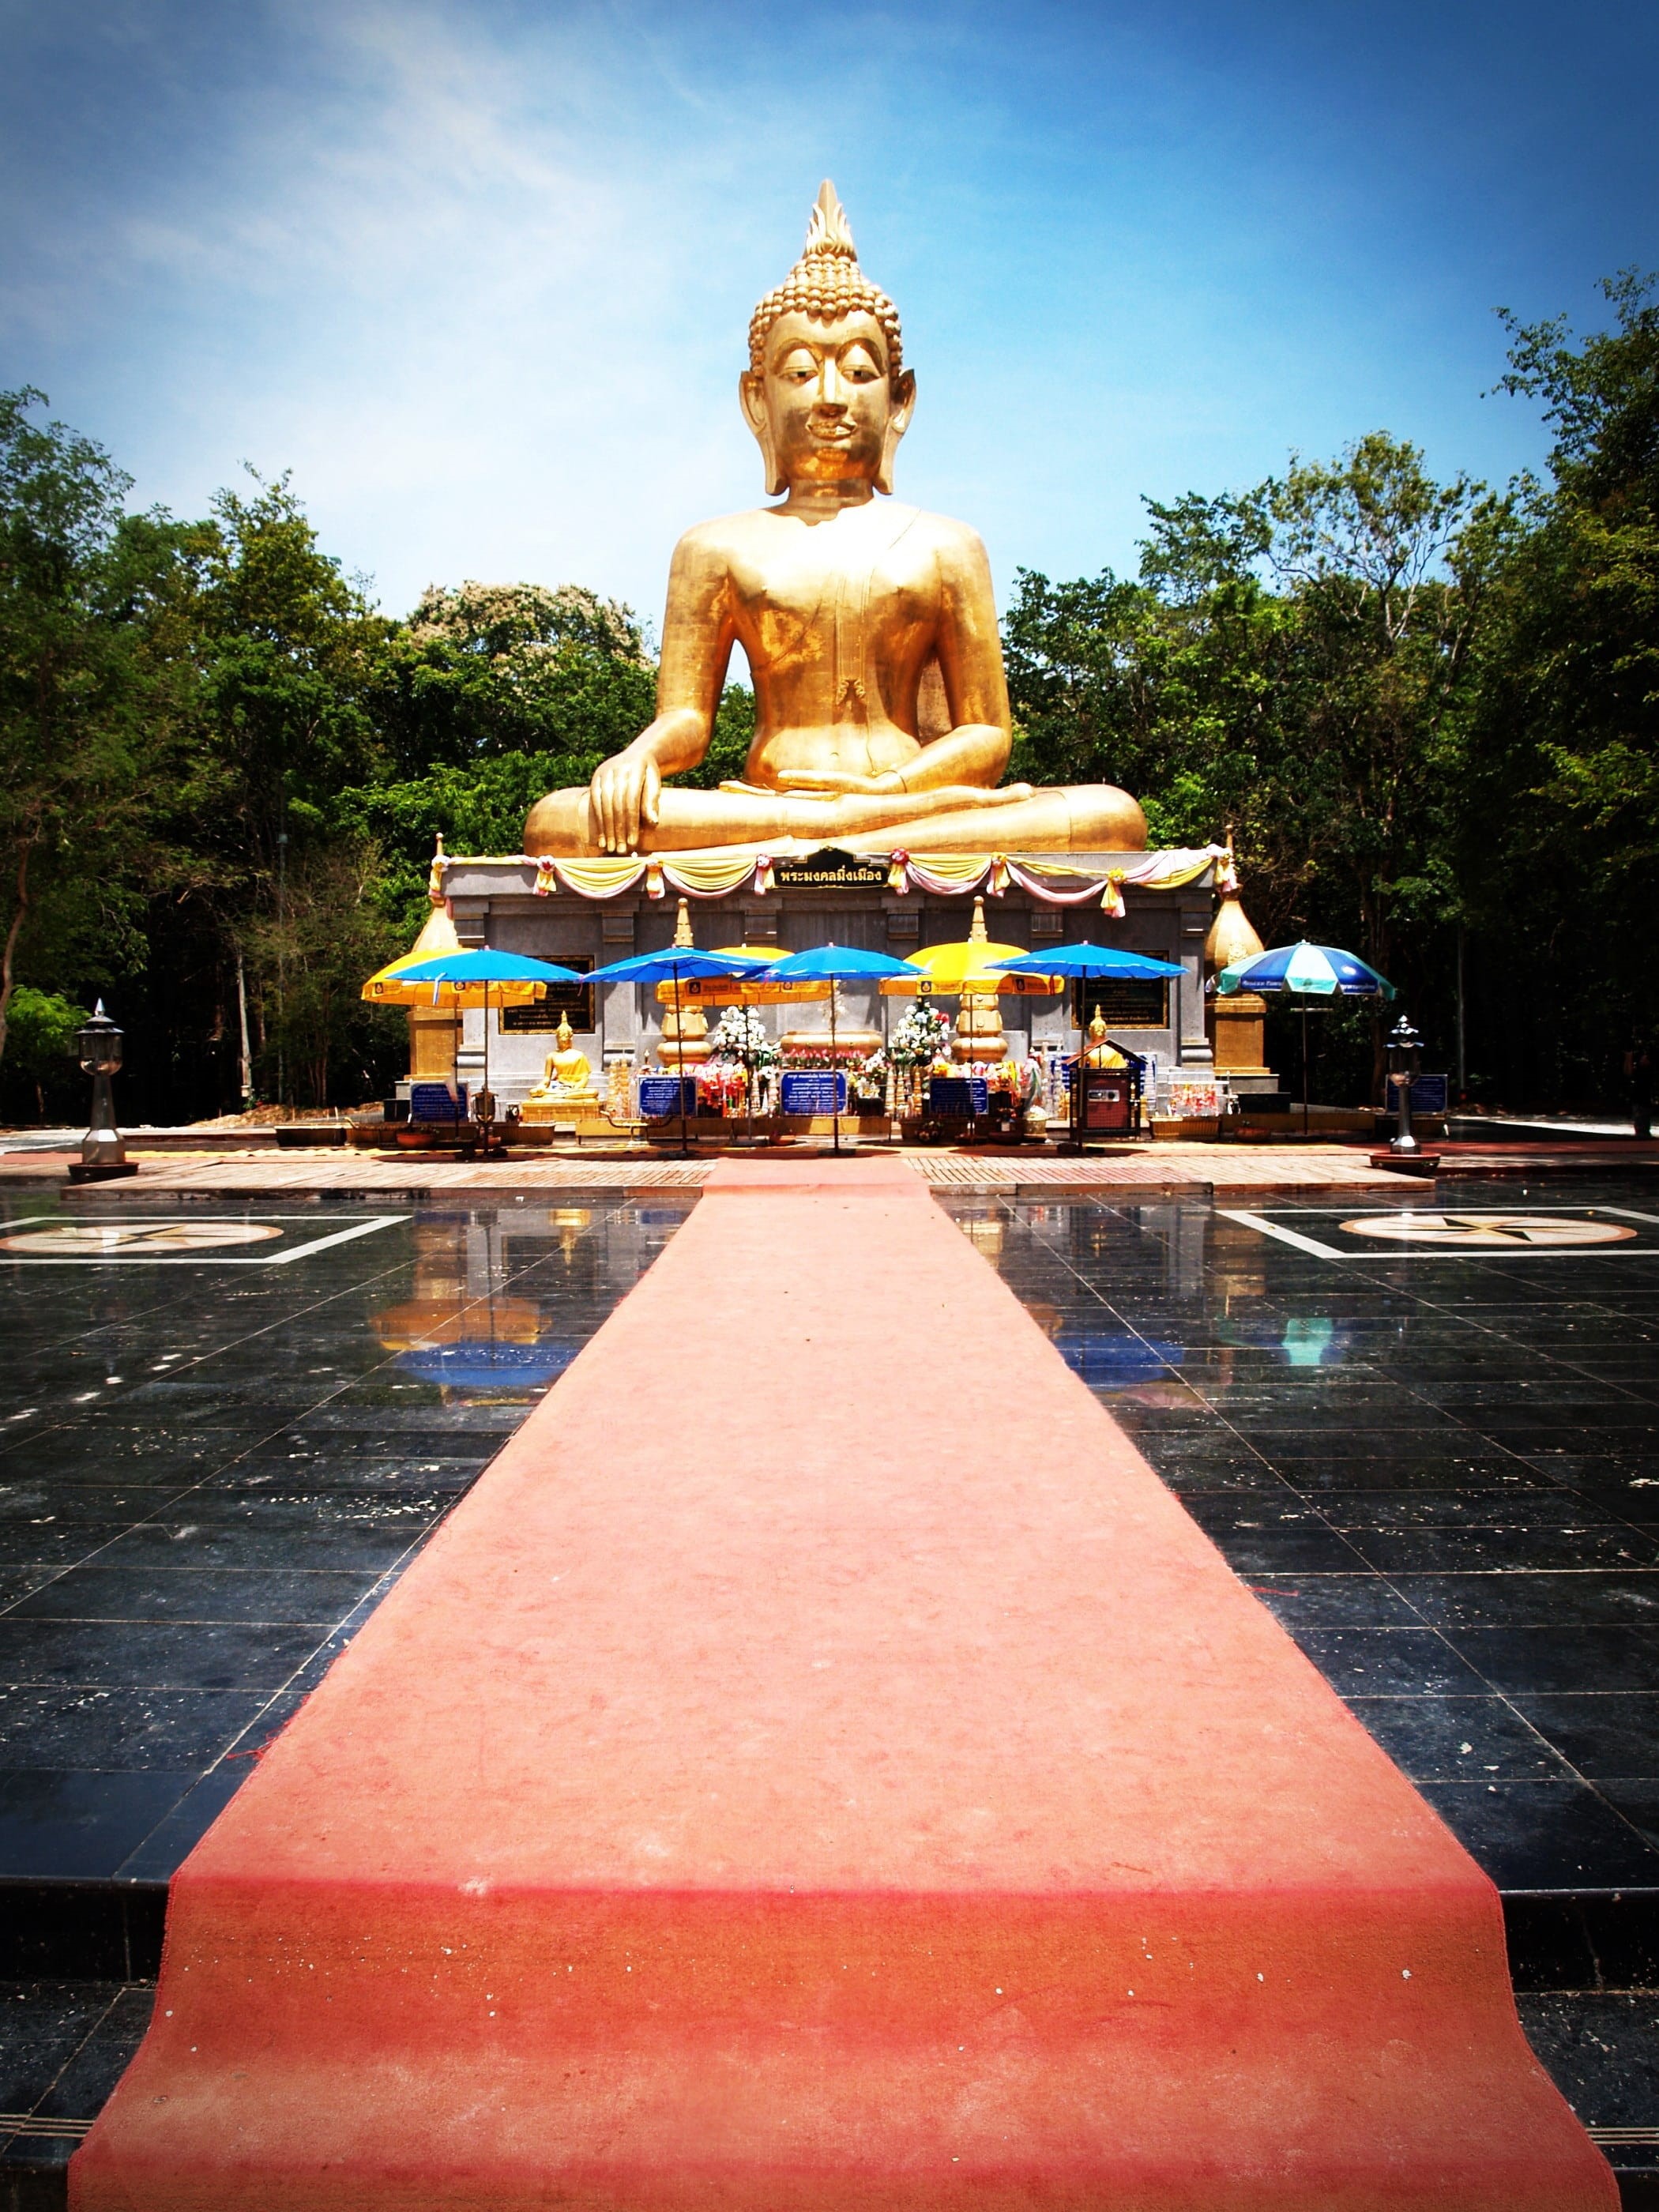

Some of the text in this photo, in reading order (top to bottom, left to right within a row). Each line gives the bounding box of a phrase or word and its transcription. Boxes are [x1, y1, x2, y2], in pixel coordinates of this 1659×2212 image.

[780, 865, 882, 882] พระมงคลมิ่งเมือง
